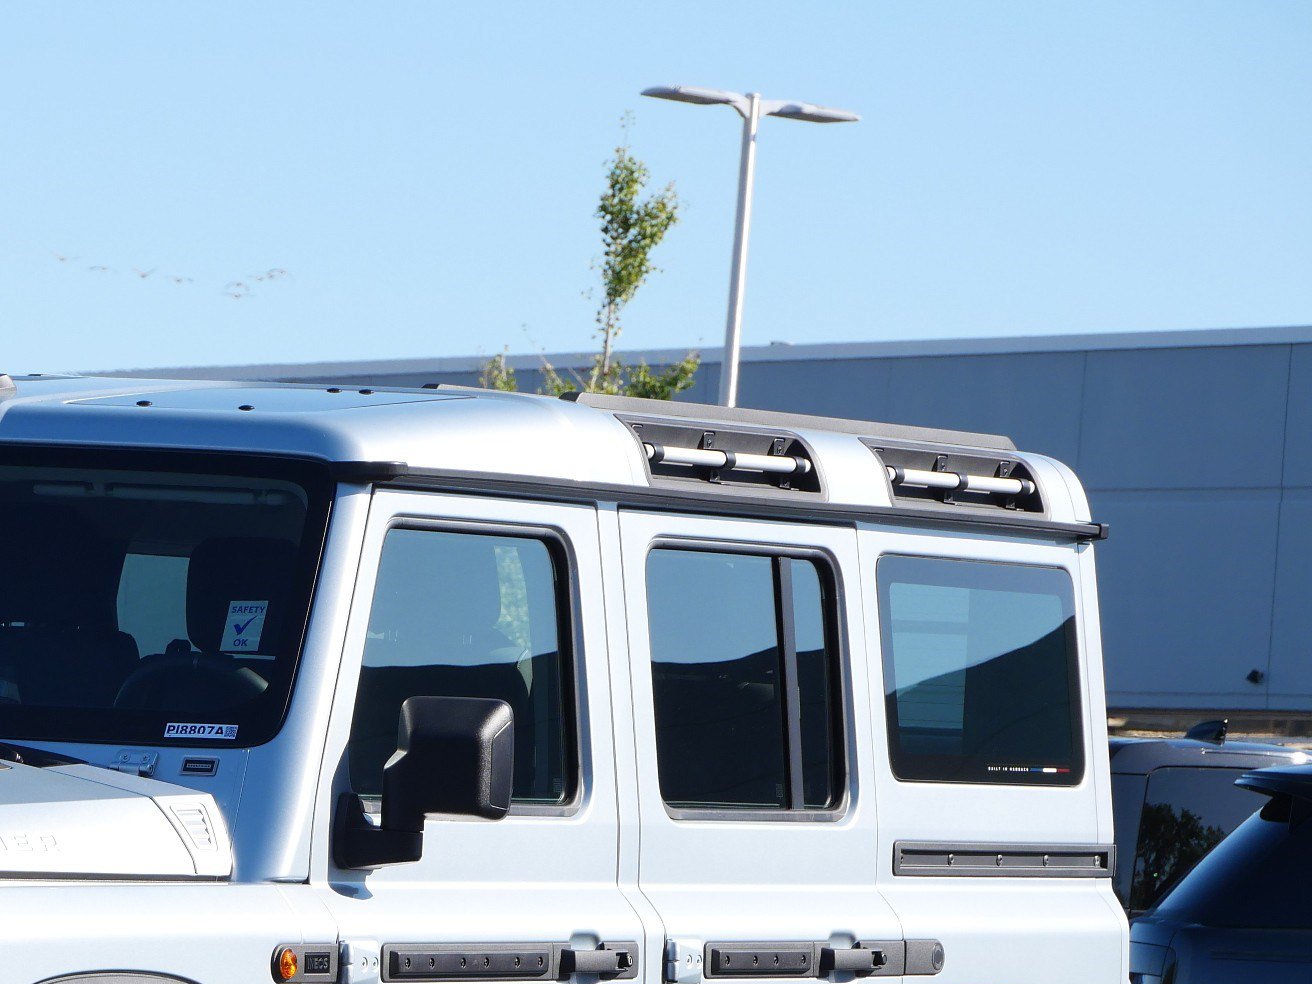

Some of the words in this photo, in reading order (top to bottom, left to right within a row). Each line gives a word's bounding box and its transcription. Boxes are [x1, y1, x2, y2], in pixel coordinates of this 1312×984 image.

[231, 605, 266, 614] SAFETY
[233, 638, 248, 647] OK
[307, 957, 328, 970] INEOS
